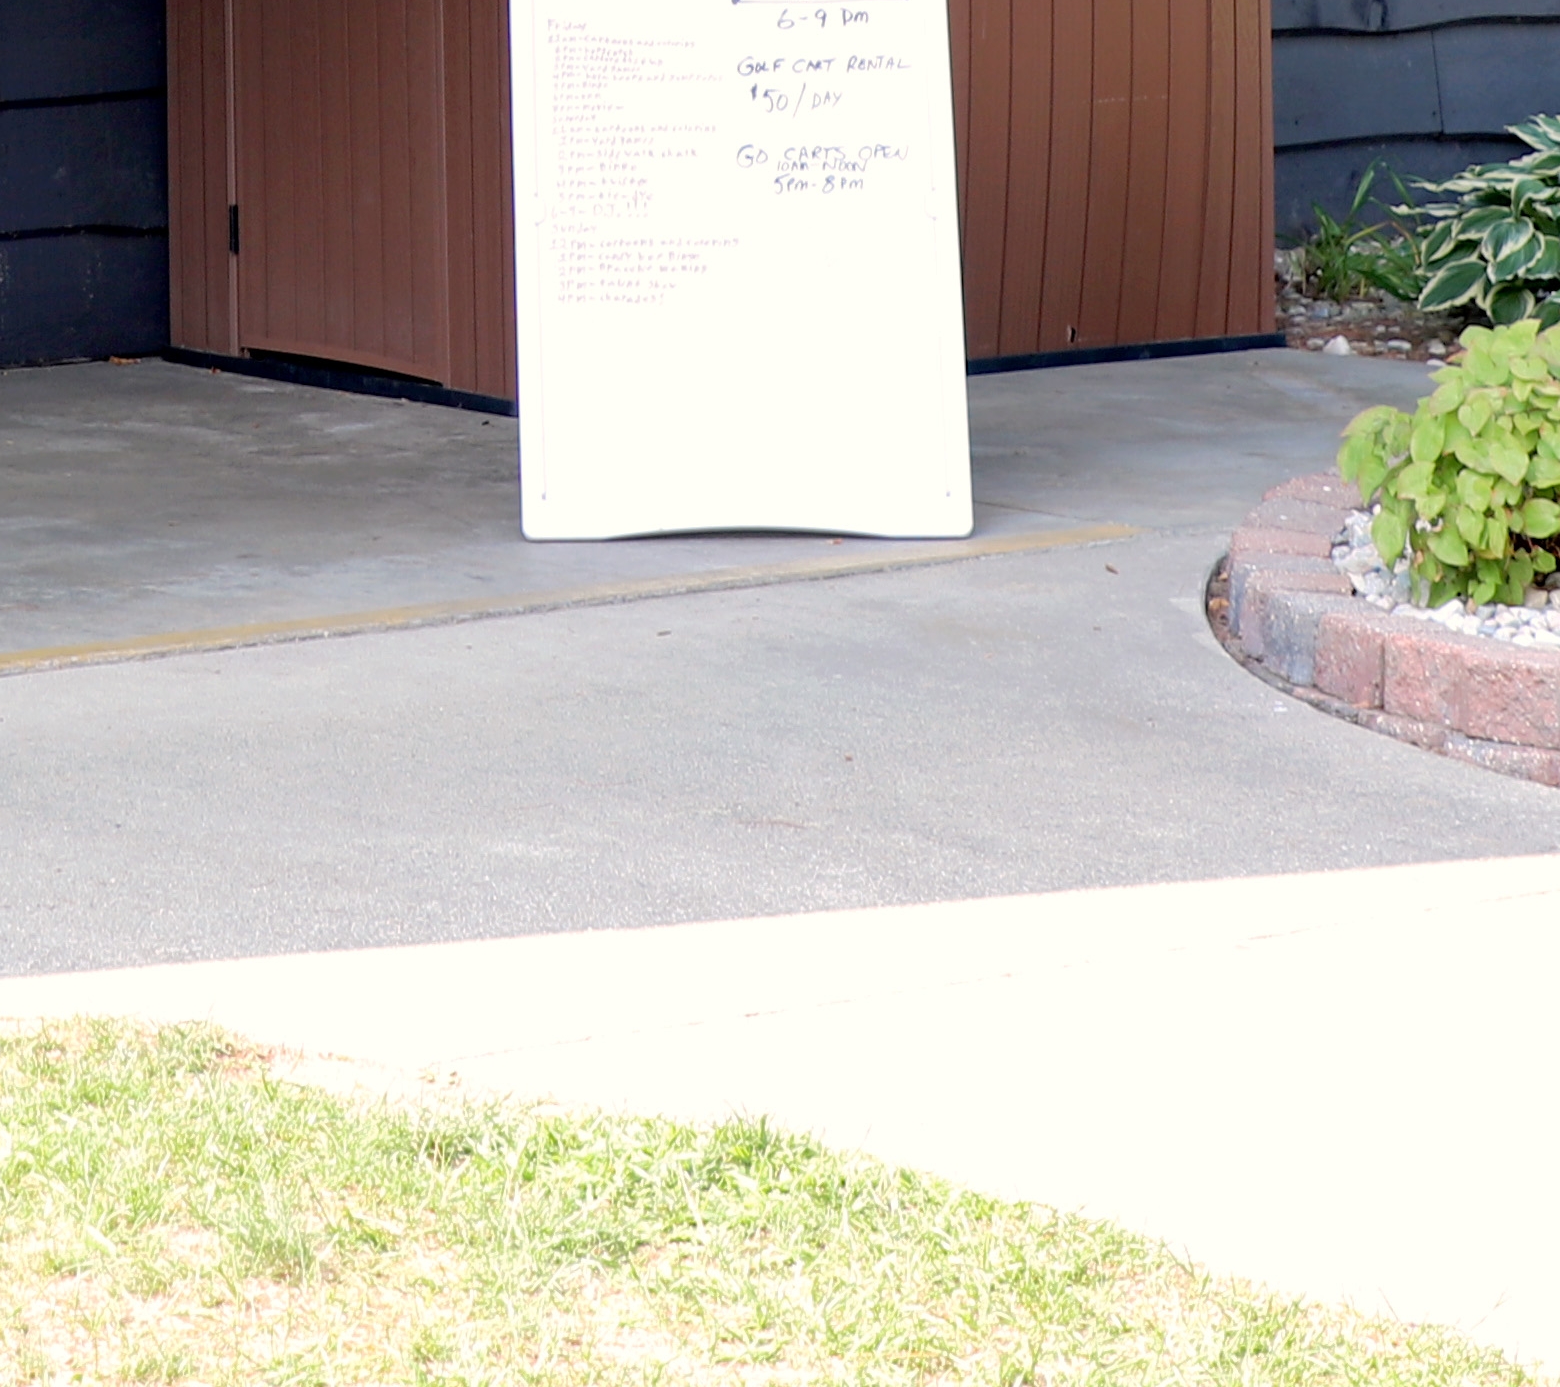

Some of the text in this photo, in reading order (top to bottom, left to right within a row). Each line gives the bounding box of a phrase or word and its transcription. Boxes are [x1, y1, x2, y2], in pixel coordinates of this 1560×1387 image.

[737, 55, 913, 77] GOLF CART RENTAL
[737, 143, 910, 169] GO CARTS OPEN
